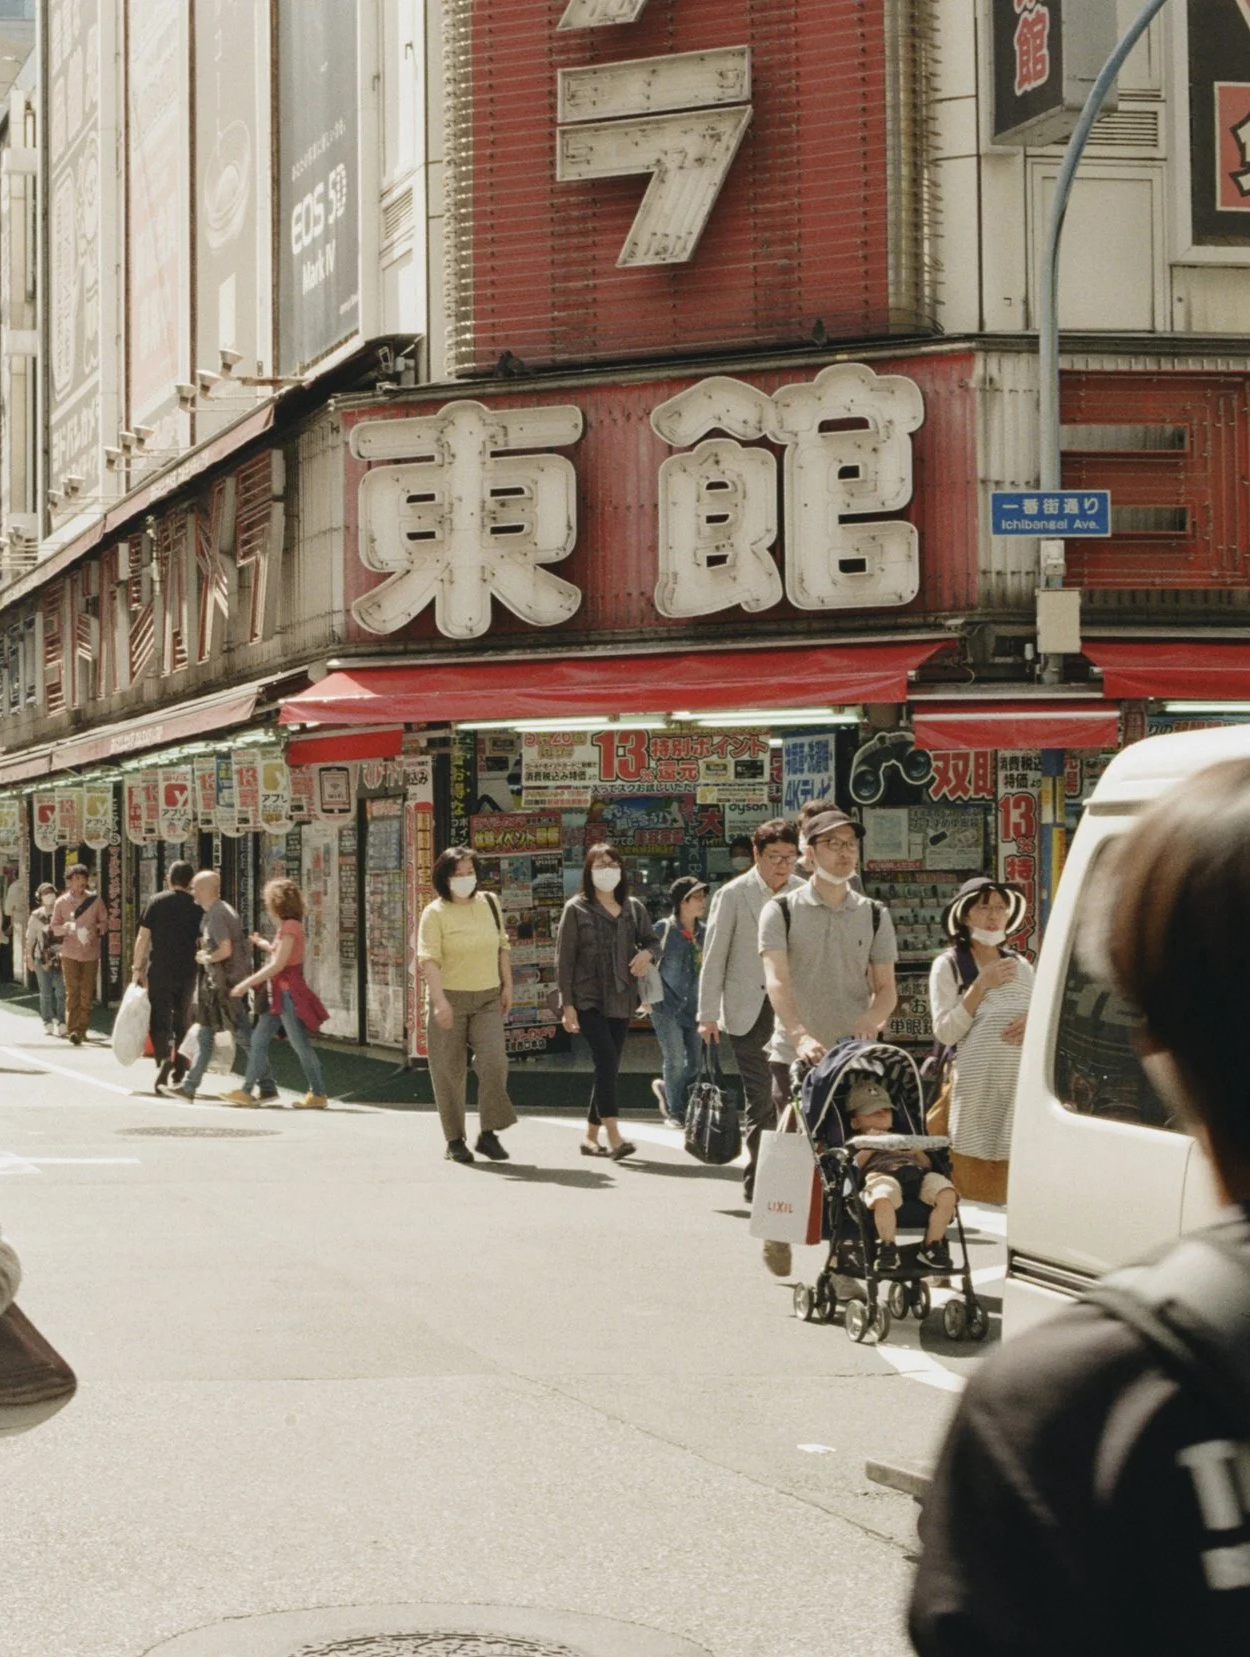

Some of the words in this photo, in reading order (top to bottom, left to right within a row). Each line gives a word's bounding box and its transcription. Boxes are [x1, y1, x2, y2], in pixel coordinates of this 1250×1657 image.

[1013, 0, 1050, 96] 館
[556, 0, 753, 268] ラ
[291, 181, 325, 256] EOS
[302, 248, 325, 296] Mark
[325, 237, 337, 277] IV
[350, 362, 926, 639] 東館
[1001, 497, 1099, 515] 一番街通り
[1001, 519, 1068, 530] Ichibangai
[1073, 519, 1101, 530] Ave.
[650, 736, 770, 760] 特別ポイント
[406, 771, 429, 787] 込み
[656, 760, 700, 784] 還元
[766, 1201, 795, 1214] LIXIL
